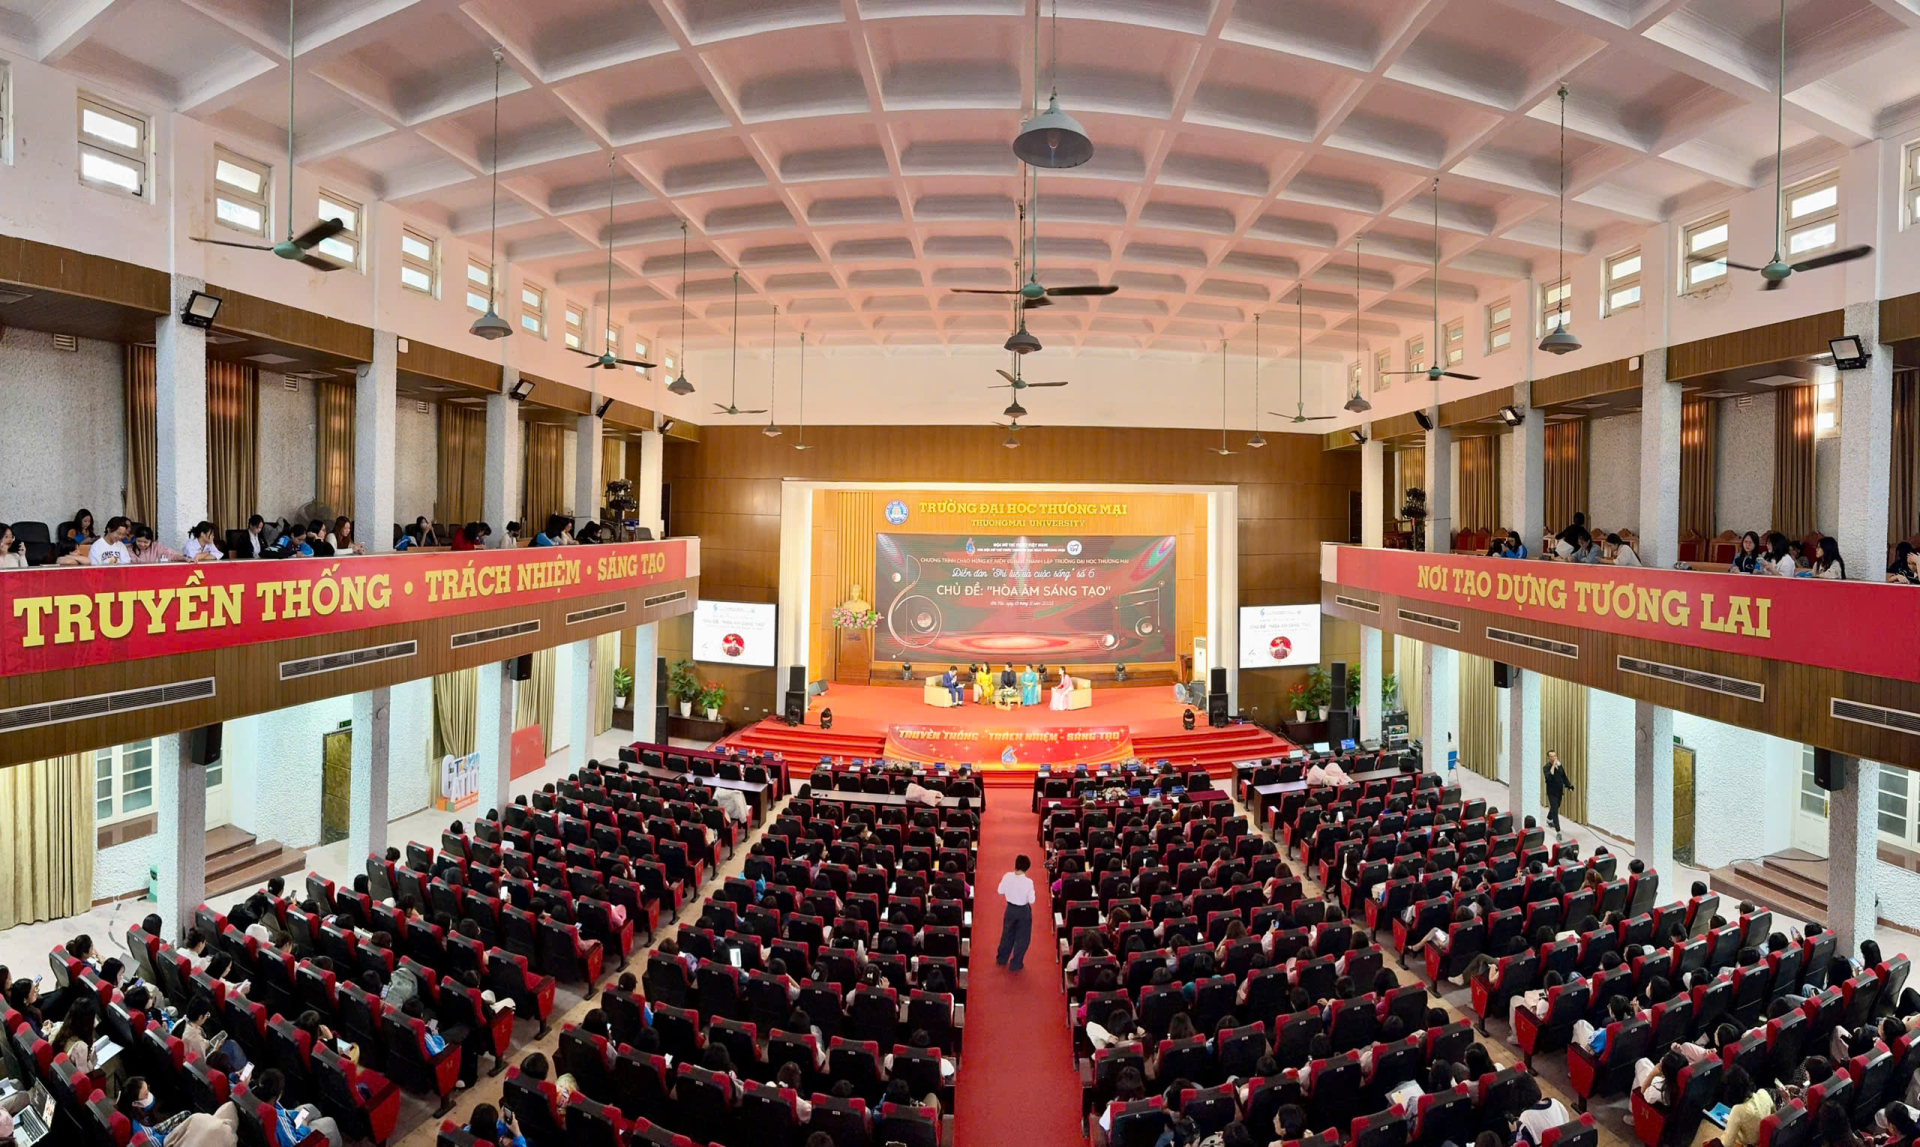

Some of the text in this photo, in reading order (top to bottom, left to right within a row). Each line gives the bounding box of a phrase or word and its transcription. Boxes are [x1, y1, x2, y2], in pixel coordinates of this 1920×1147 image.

[918, 498, 978, 514] TRƯỜNG
[979, 503, 1005, 517] ĐẠI
[1006, 502, 1037, 517] HỌC
[1038, 501, 1098, 515] THƯƠNG
[1099, 504, 1128, 517] MẠI
[971, 519, 1086, 527] THUONGMAI UNIVERSITY
[936, 581, 1111, 598] CHỦ ĐỀ: "HÒA ÂM SÁNG TẠO"
[13, 551, 666, 647] TRUYỀN THỐNG TRÁCH NHIỆM SÁNG TẠO
[1417, 564, 1771, 638] NƠI TẠO DỰNG TƯƠNG LAI
[899, 728, 941, 740] TRUYỀN
[1066, 731, 1096, 741] SÁNG
[1097, 731, 1120, 742] TẠO
